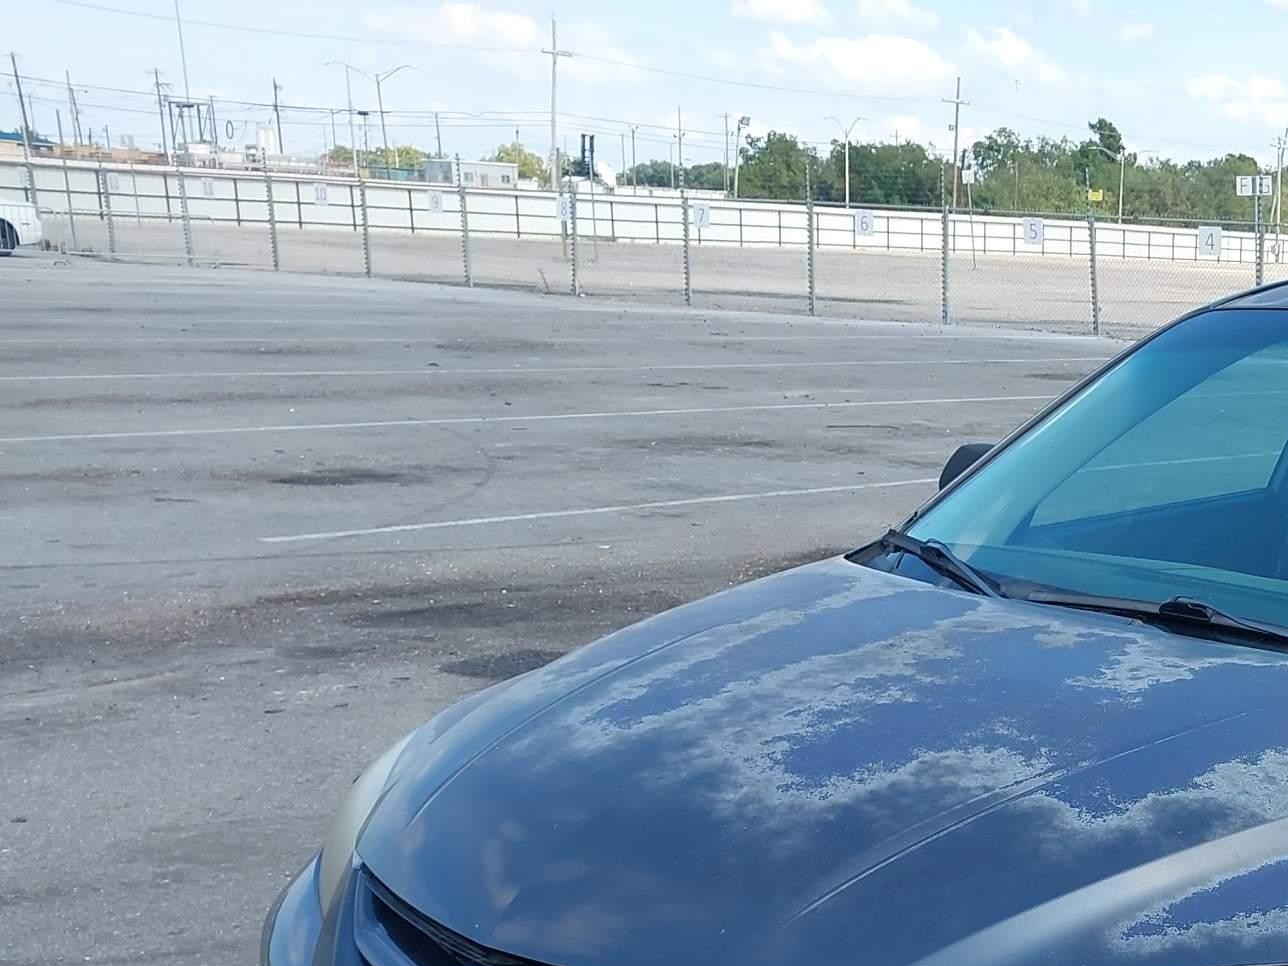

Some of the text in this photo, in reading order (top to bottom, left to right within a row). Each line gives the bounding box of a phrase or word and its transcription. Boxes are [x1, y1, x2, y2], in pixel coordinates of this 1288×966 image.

[1240, 177, 1248, 193] F
[314, 187, 327, 201] 10
[431, 195, 439, 209] 9
[560, 202, 568, 216] 8
[698, 208, 705, 223] 7
[860, 215, 869, 232] 6
[1029, 223, 1038, 240] 5
[1205, 232, 1215, 250] 4
